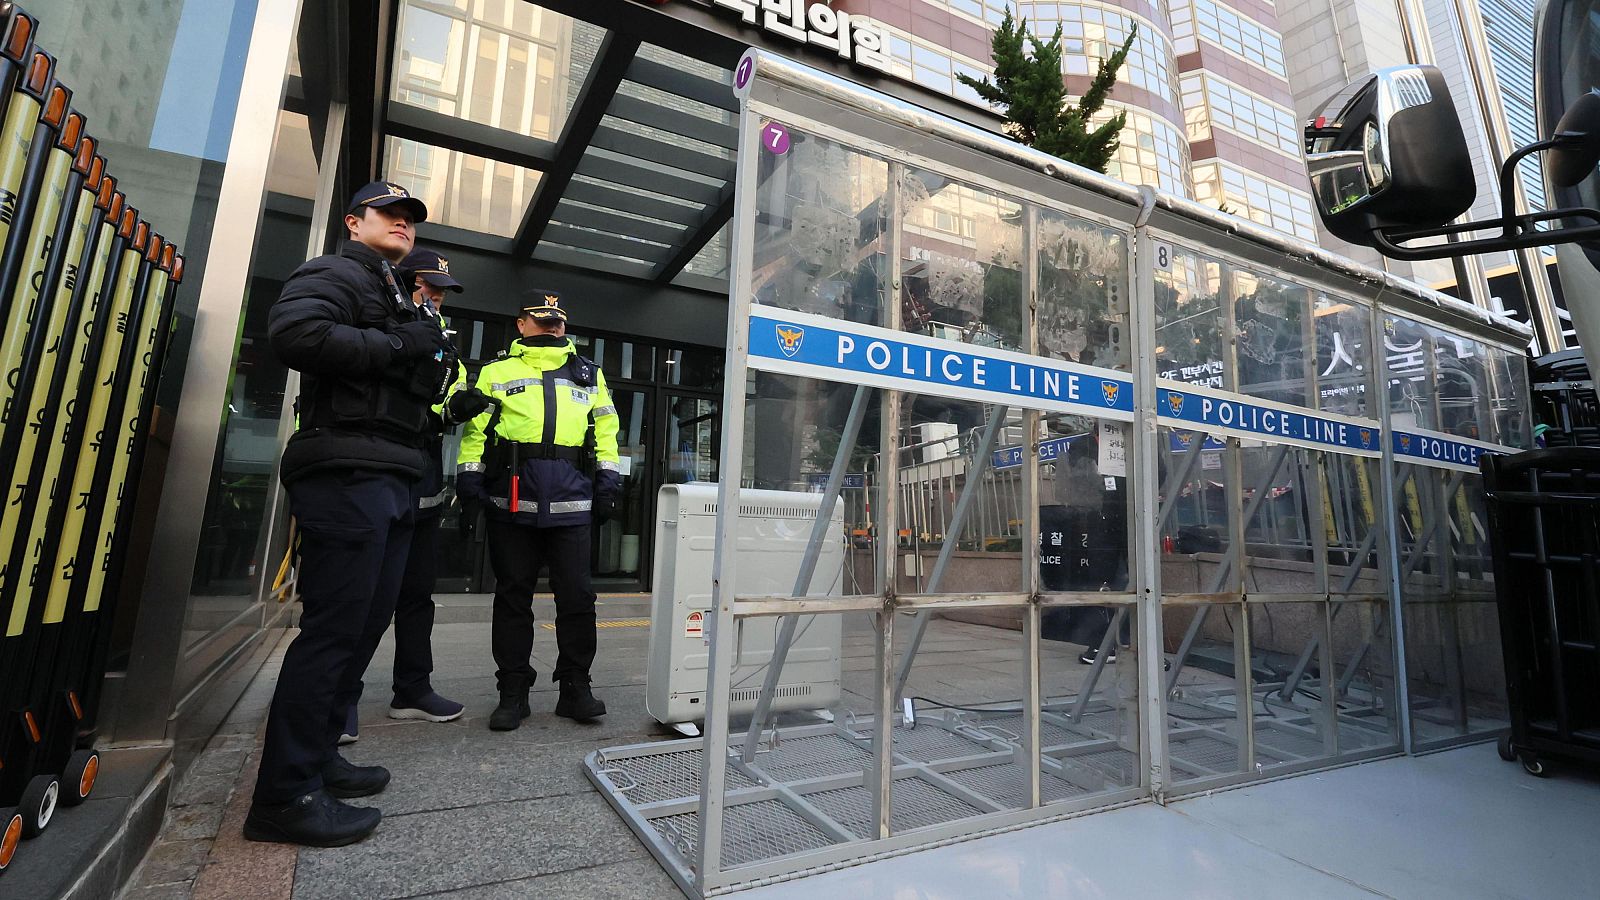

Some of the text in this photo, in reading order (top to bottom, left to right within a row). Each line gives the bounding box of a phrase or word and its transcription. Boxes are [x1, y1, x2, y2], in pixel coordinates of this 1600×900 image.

[770, 127, 783, 148] 7
[1158, 245, 1168, 268] 8
[837, 335, 1080, 400] POLICE LINE
[1202, 398, 1347, 445] POLICE LINE
[1420, 437, 1477, 464] POLICE
[1039, 555, 1062, 565] OLICE
